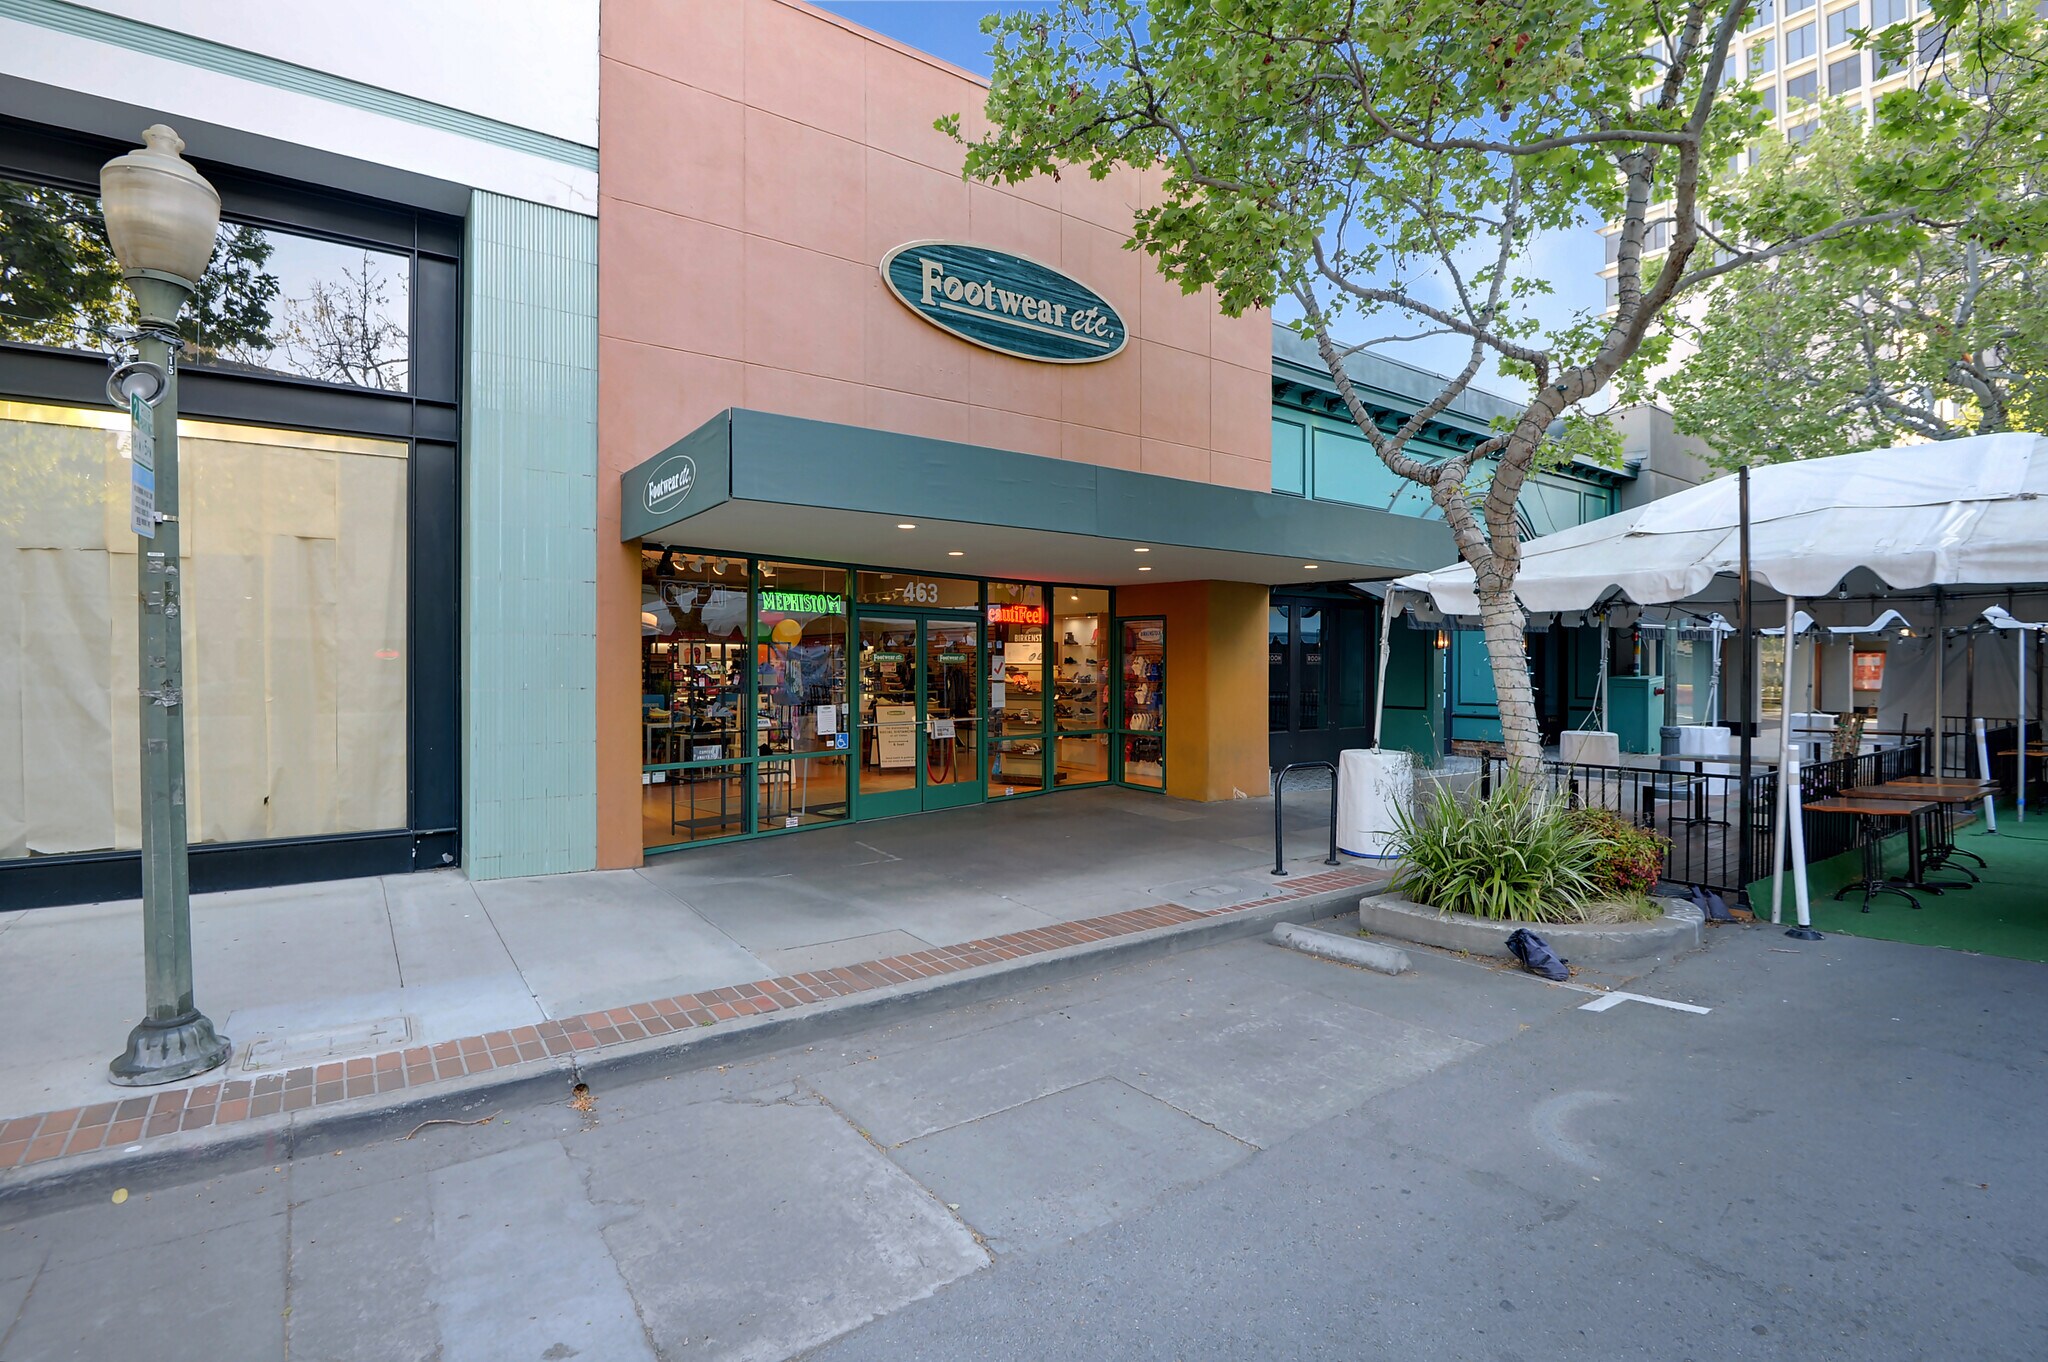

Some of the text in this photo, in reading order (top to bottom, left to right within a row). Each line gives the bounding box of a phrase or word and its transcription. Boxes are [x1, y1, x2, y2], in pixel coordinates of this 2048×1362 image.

[919, 258, 1115, 339] Footwear etc.
[648, 473, 679, 507] Footwear
[903, 582, 938, 603] 463
[988, 605, 1043, 624] eautiFeel
[1014, 634, 1042, 642] BIRKENST
